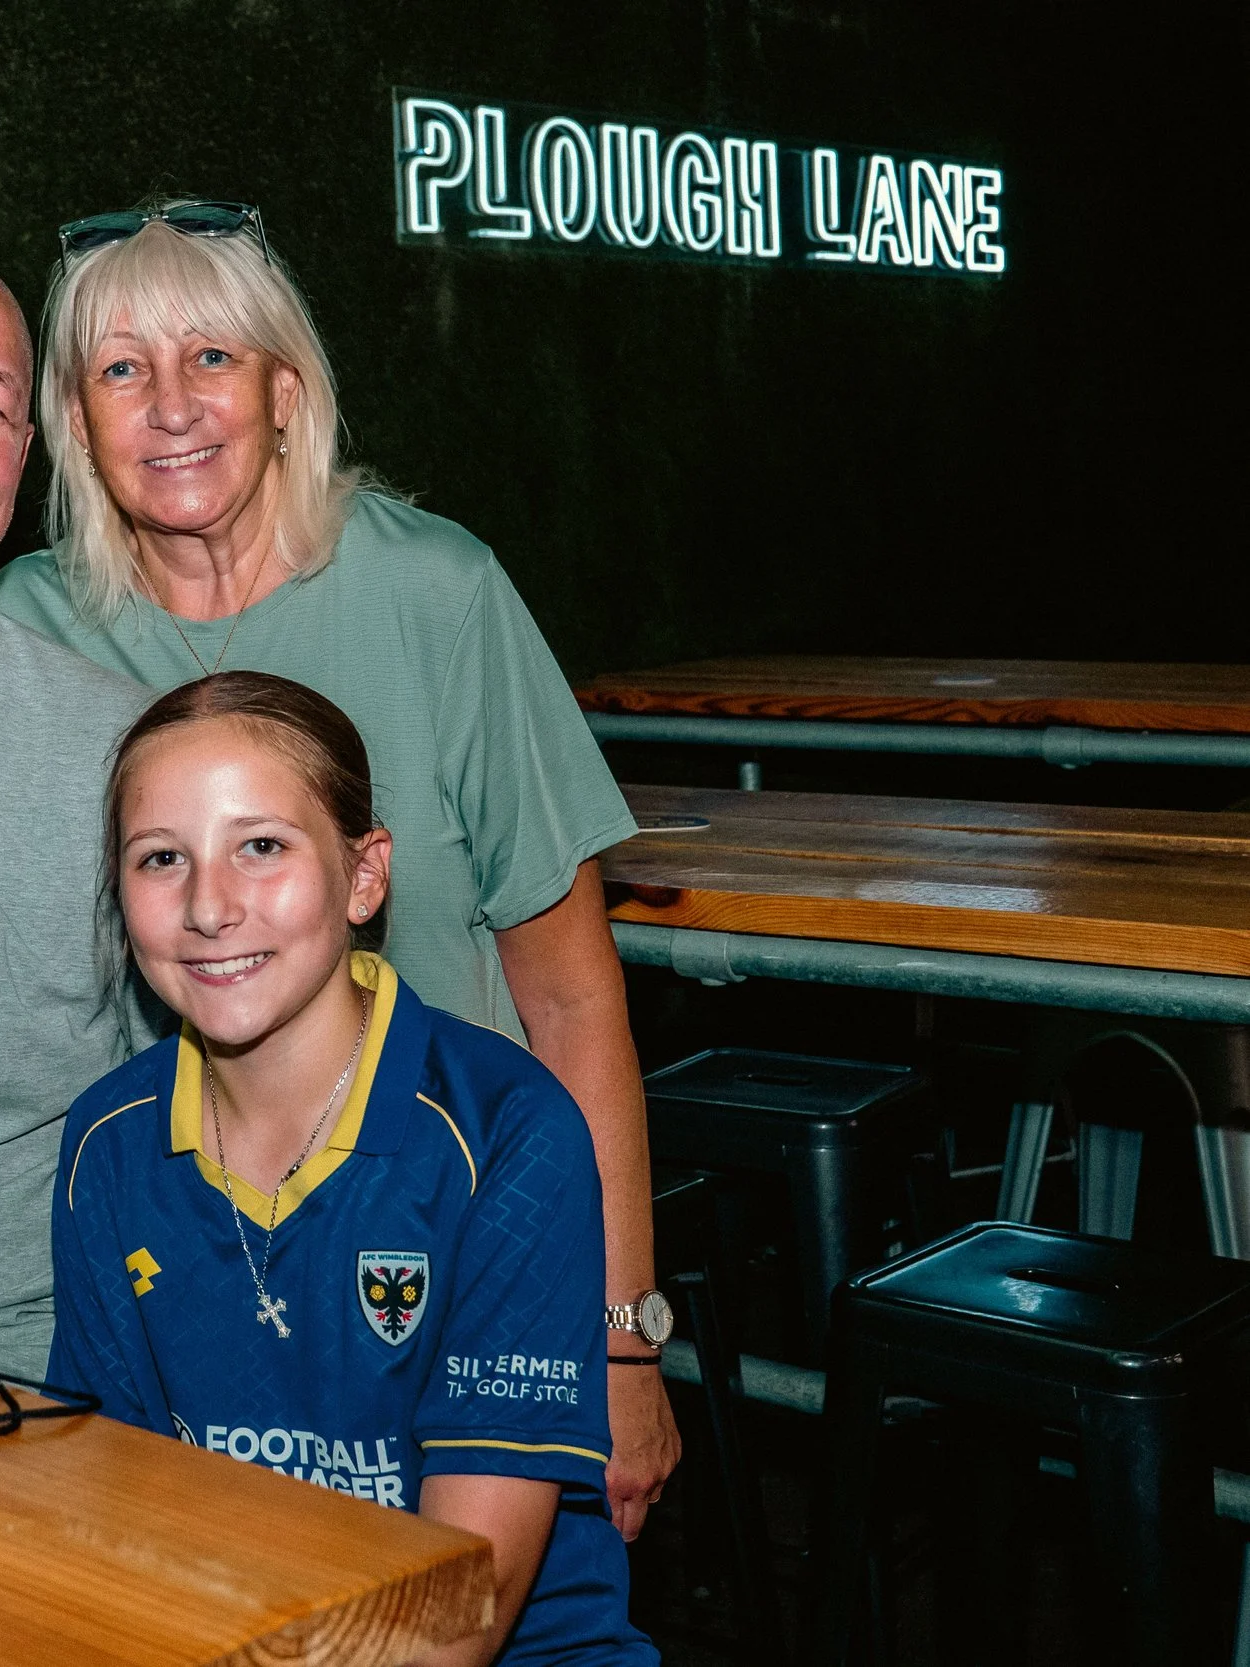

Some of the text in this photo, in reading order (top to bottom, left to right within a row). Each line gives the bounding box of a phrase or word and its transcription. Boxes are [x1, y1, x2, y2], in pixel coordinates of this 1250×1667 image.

[401, 97, 1006, 273] PLOUGH LANE
[377, 1254, 425, 1262] WIMBLEDON
[446, 1354, 583, 1381] SILERMER
[476, 1379, 531, 1399] GOLF
[205, 1424, 401, 1475] FOOTBALL
